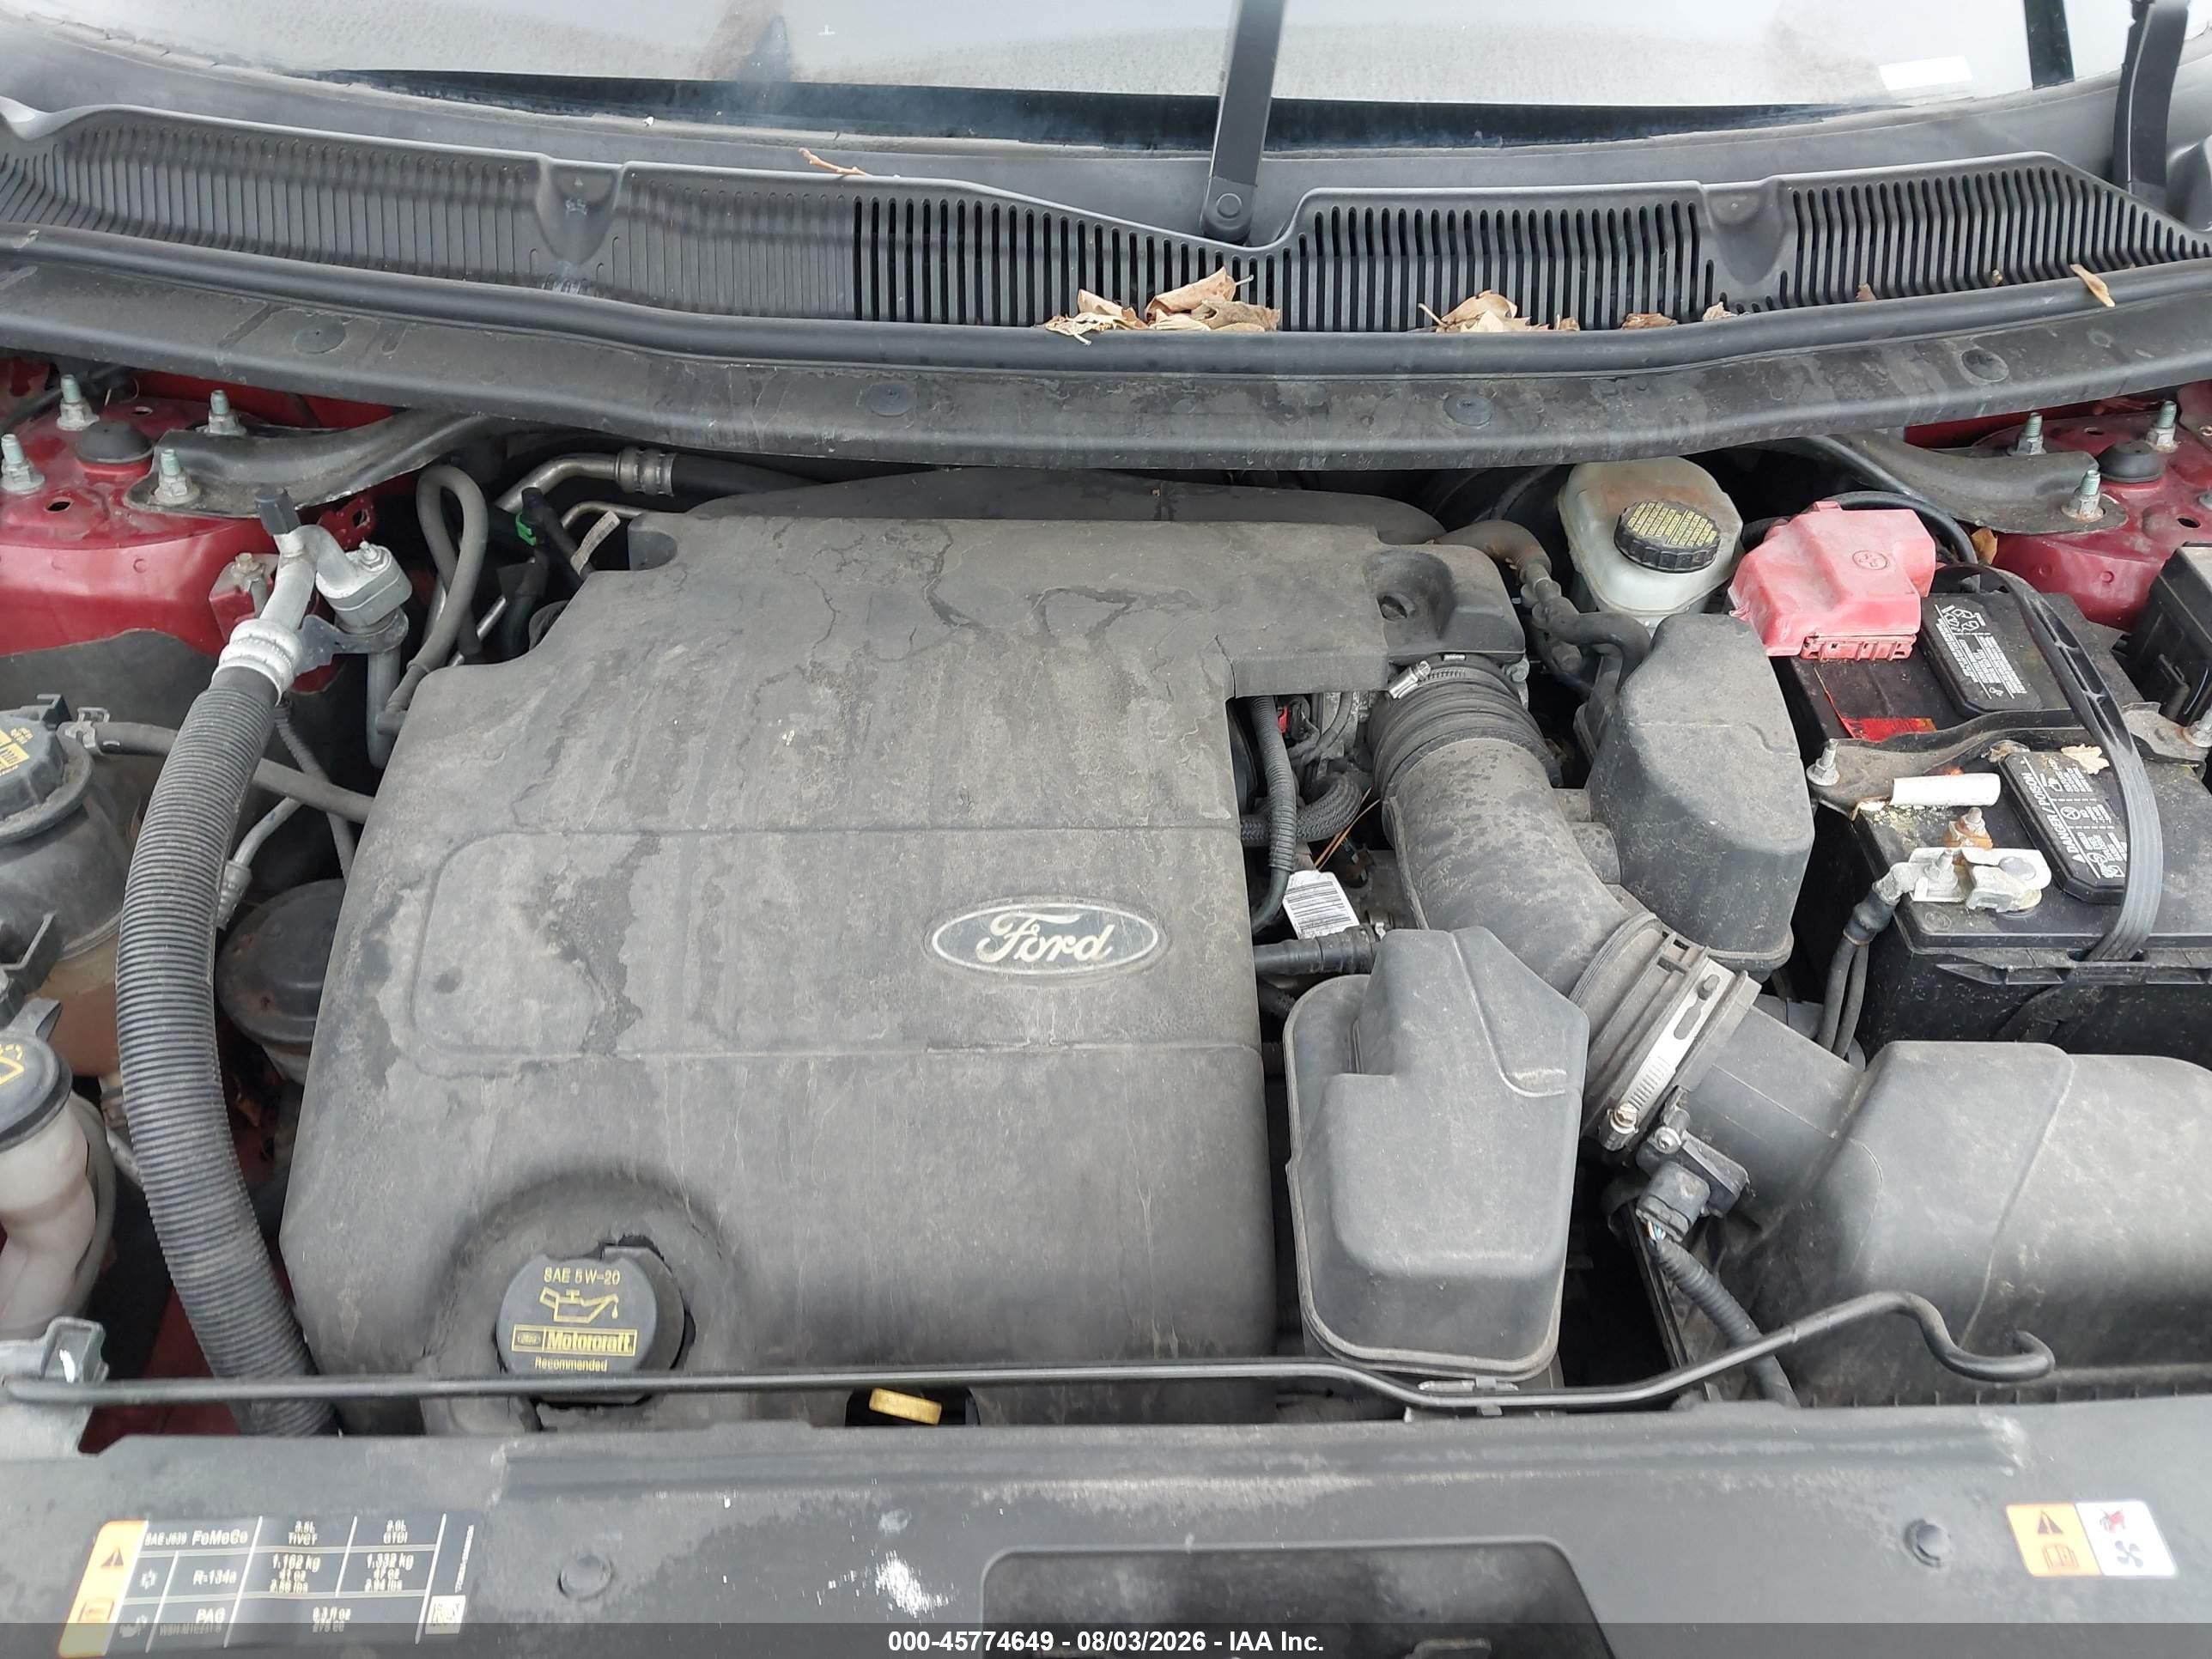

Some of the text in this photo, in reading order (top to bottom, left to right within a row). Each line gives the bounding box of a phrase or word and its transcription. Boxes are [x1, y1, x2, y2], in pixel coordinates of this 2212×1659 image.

[2021, 773, 2050, 806] POISON
[2046, 814, 2078, 854] DANGER
[975, 912, 1115, 963] Ford
[544, 1267, 621, 1285] SAE 5W-20
[547, 1330, 632, 1353] Motorcraft
[534, 1356, 608, 1372] Recommended
[191, 1528, 248, 1546] FoMoCo
[306, 1554, 321, 1573] kg
[398, 1553, 414, 1571] kg
